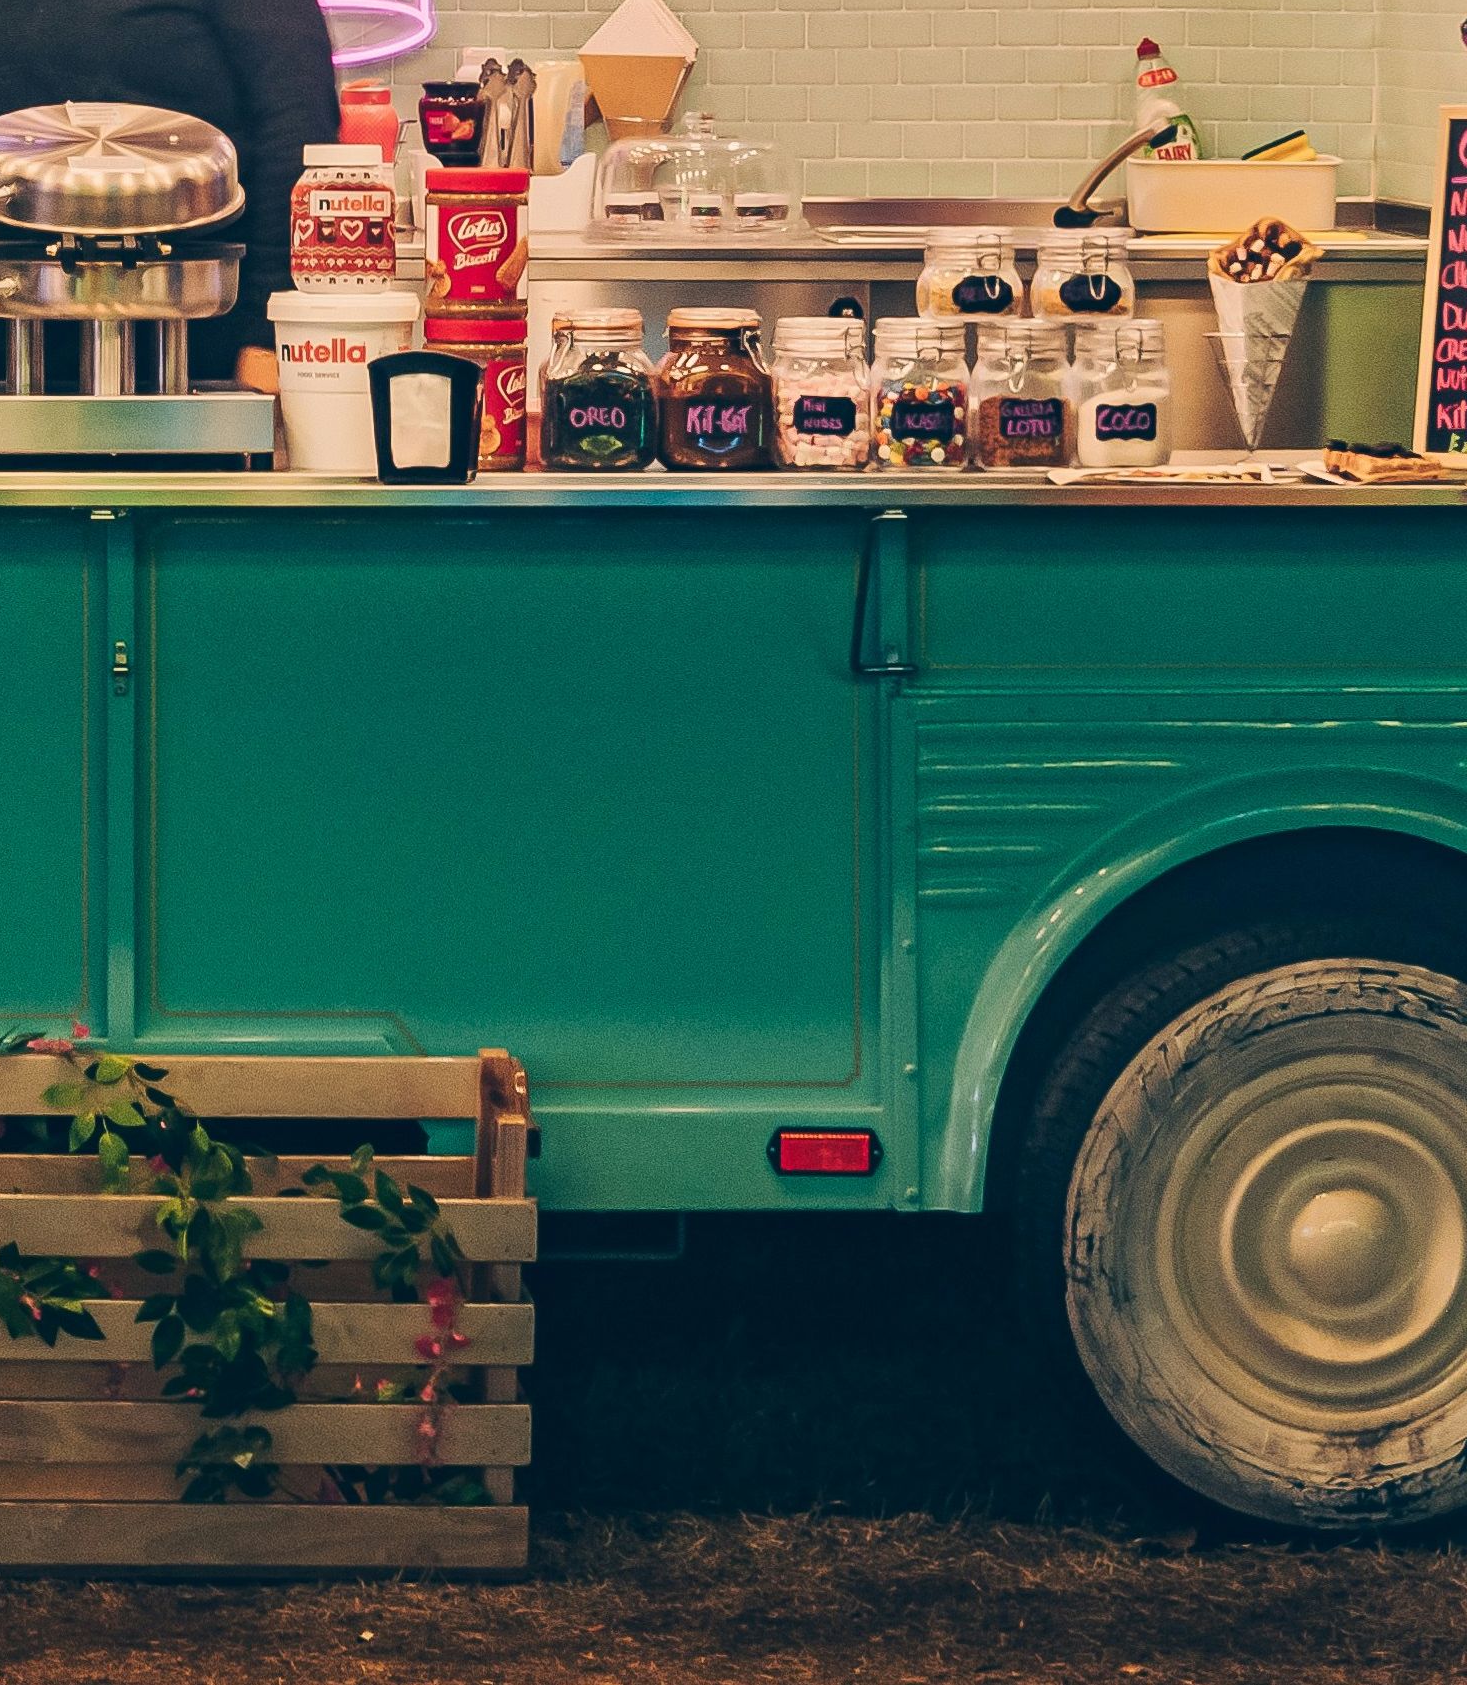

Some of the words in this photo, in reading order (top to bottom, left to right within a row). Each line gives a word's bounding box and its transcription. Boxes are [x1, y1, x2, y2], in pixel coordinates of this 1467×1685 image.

[317, 195, 386, 213] nutella
[457, 214, 502, 241] Lotus
[280, 338, 367, 364] nutella
[570, 408, 626, 429] OREO
[1096, 407, 1151, 431] COCO
